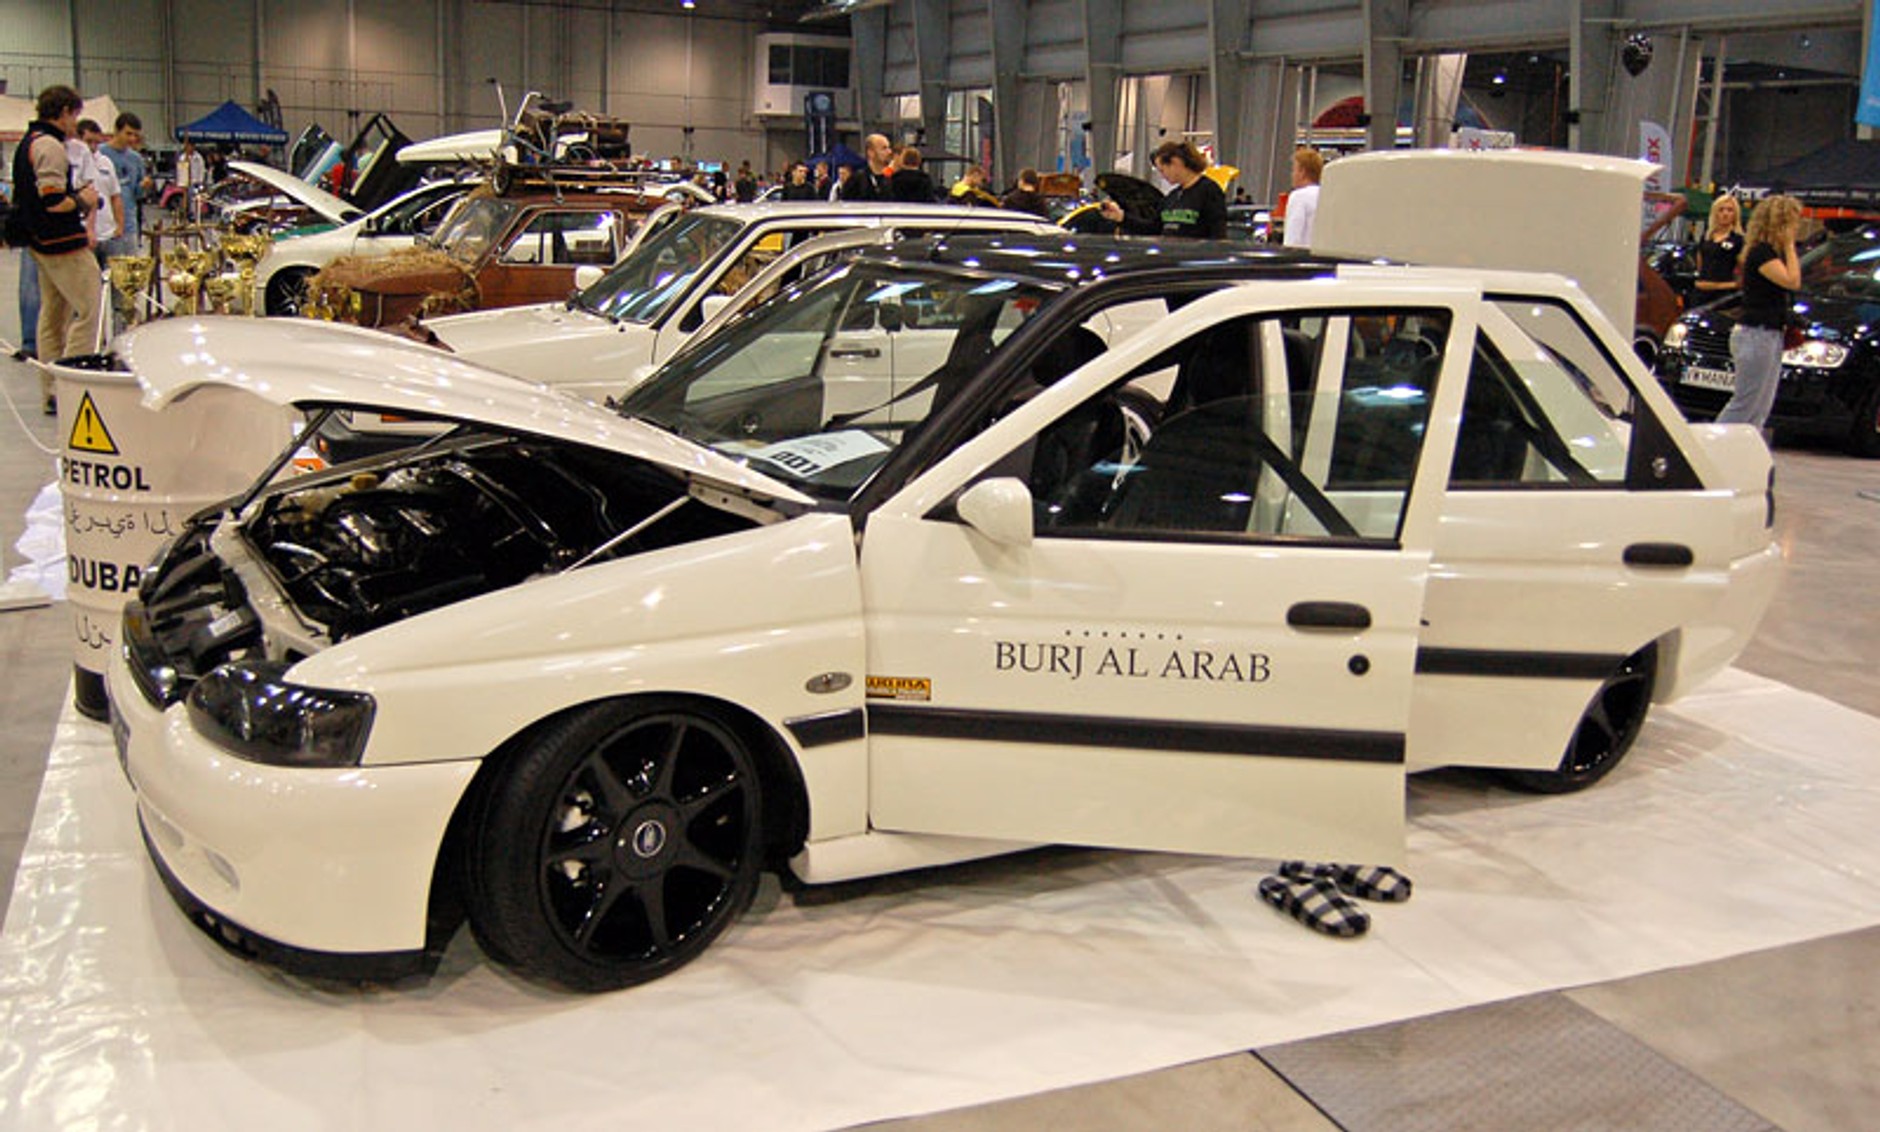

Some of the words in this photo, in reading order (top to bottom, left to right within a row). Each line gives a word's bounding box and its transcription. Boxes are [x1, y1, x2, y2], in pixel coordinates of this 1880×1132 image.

[63, 456, 151, 491] PETROL
[70, 554, 140, 593] DUBA
[995, 641, 1085, 680] BURJ
[1096, 647, 1149, 677] AL
[1159, 650, 1271, 683] ARAB
